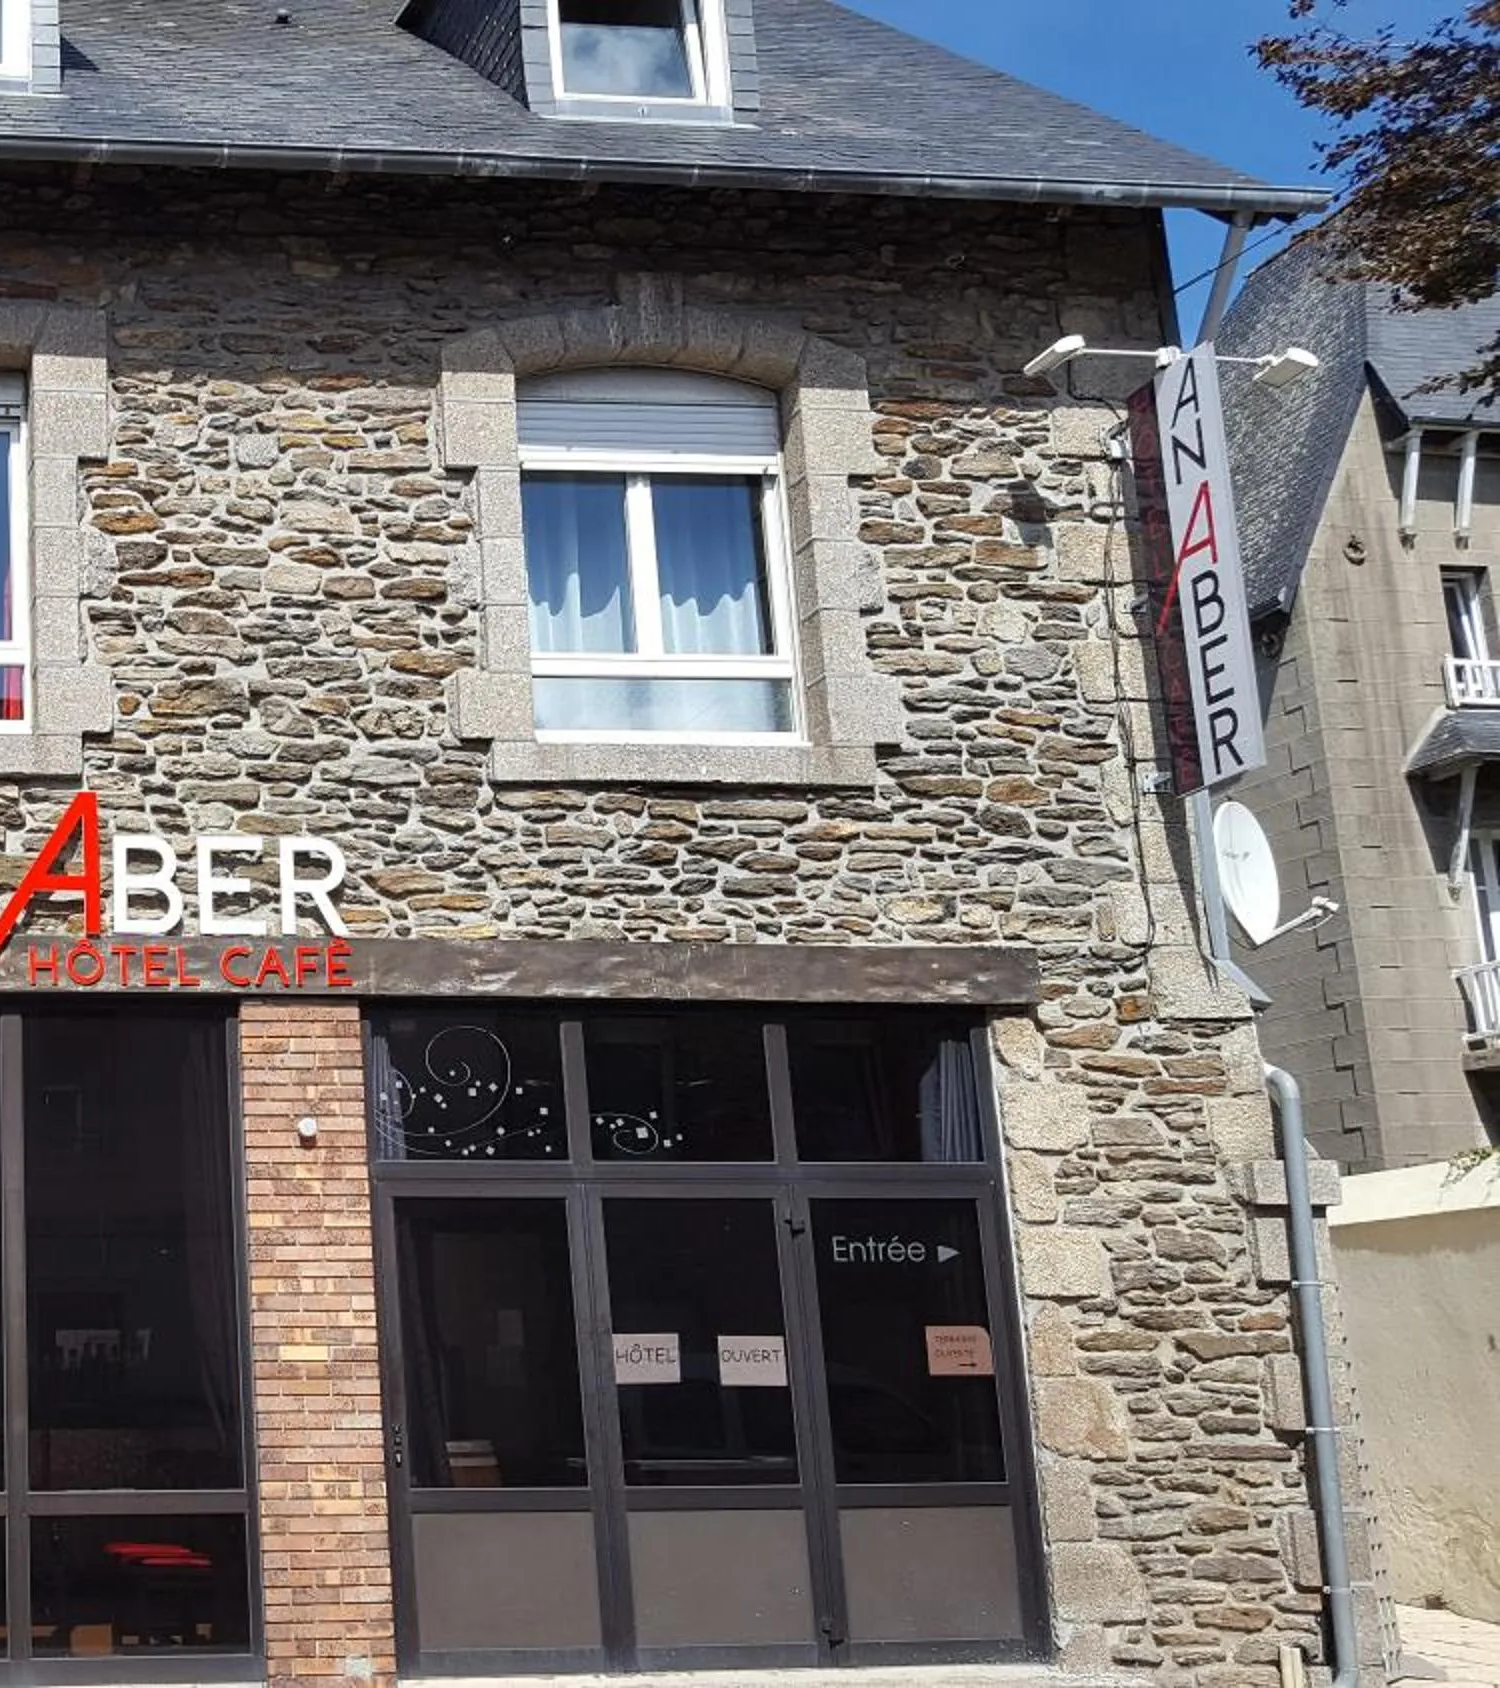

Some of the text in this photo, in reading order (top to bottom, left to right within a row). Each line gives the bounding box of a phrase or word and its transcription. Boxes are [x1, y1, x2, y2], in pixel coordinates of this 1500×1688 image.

[1157, 357, 1244, 775] AN ABER
[27, 936, 353, 987] HÔTEL CAFÉ
[832, 1235, 926, 1262] Entrée
[615, 1343, 676, 1364] HÔTEL
[721, 1348, 782, 1363] OUVERT
